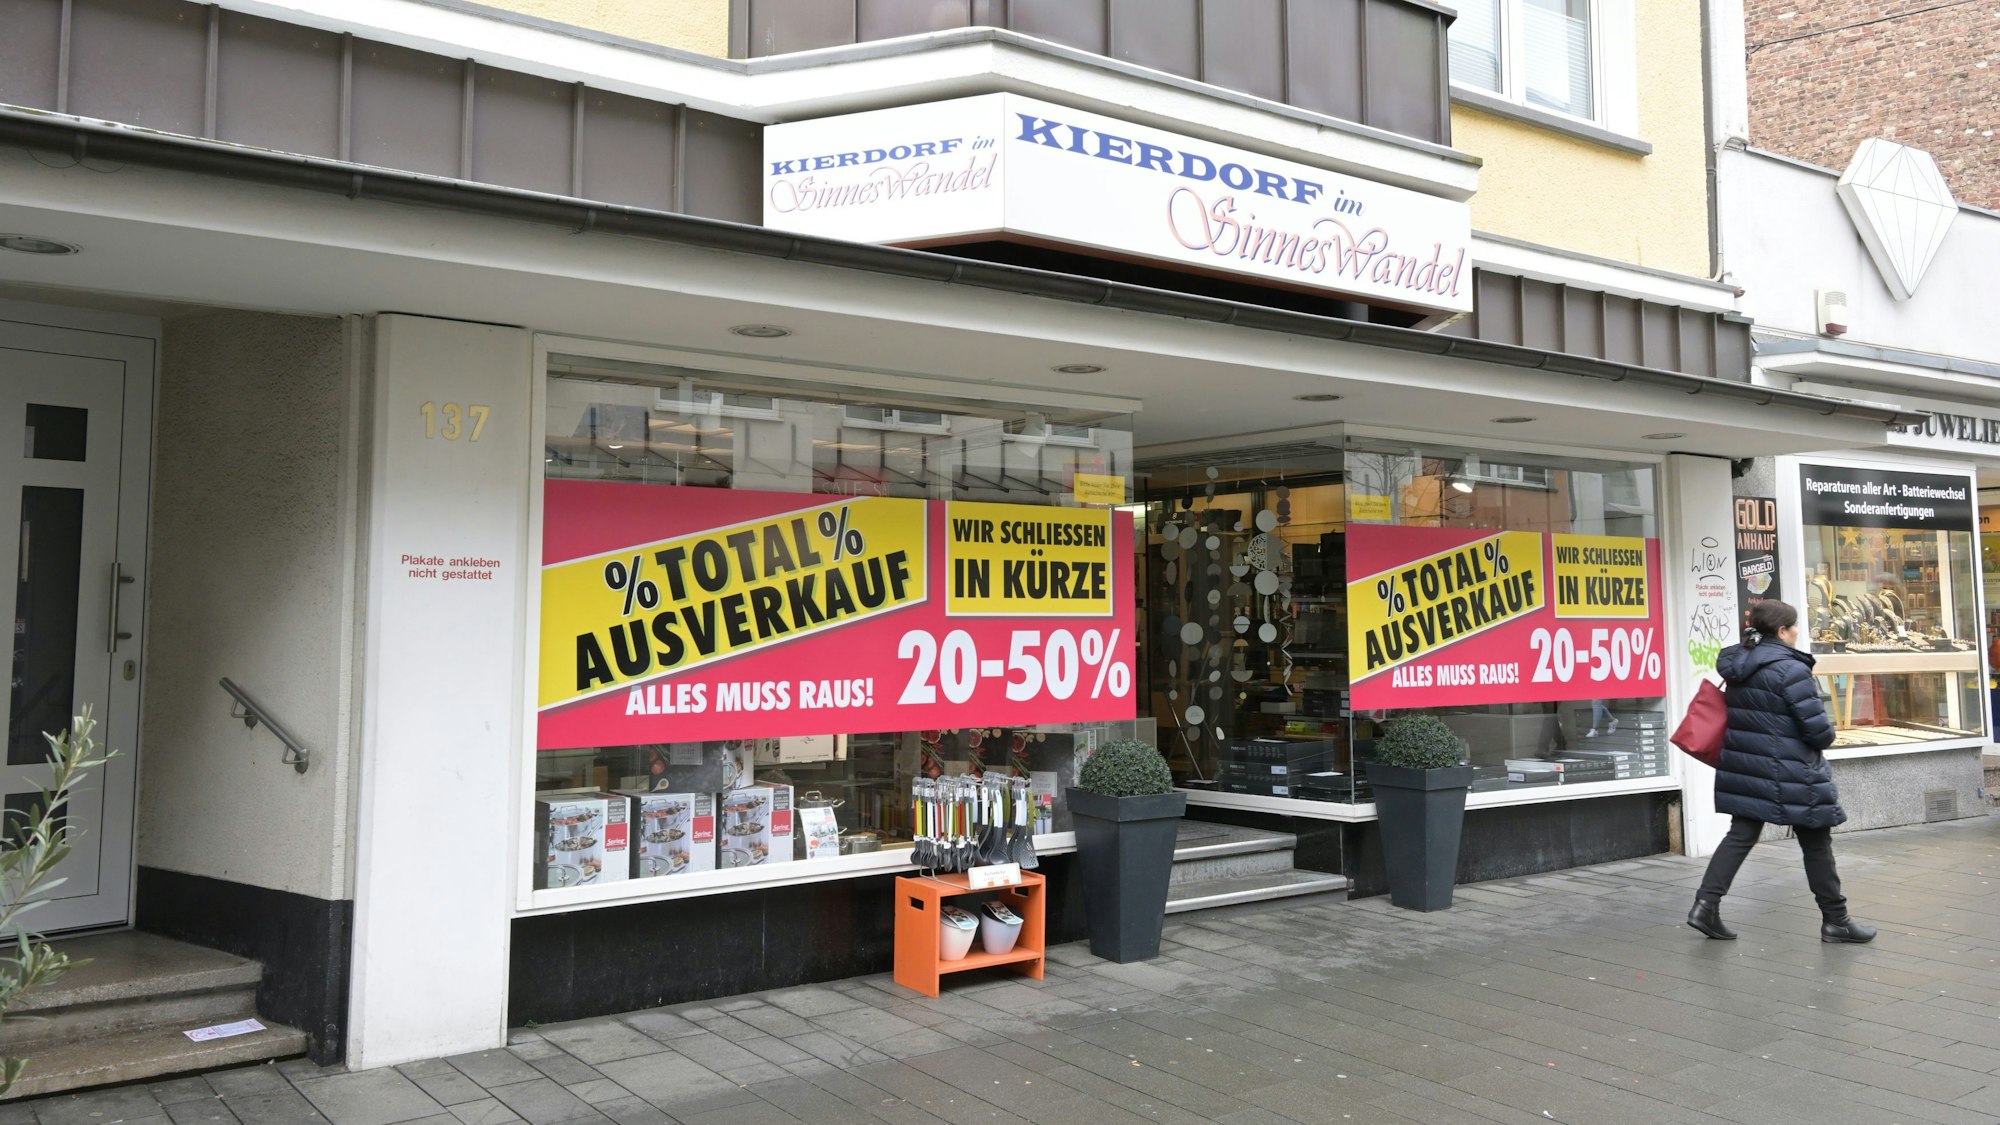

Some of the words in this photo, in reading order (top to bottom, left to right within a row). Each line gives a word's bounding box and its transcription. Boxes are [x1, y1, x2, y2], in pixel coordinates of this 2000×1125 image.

[770, 138, 962, 176] KIERDORF
[972, 136, 995, 150] im
[1018, 113, 1323, 204] KIERDORF
[1334, 189, 1364, 217] im
[770, 152, 998, 213] SinnesWandel
[1167, 186, 1466, 299] SinnesWandel
[420, 401, 490, 442] 137
[1806, 478, 1861, 496] Reparaturen
[1862, 481, 1882, 495] aller
[1883, 483, 1897, 496] Art
[1903, 485, 1966, 500] Batteriewechsel
[1736, 498, 1776, 531] GOLD
[1844, 501, 1935, 520] Sonderanfertigungen
[953, 518, 994, 544] WIR
[1000, 521, 1106, 548] SCHLIESSEN
[1737, 532, 1776, 551] ANKAUF
[401, 555, 445, 566] Plakate
[449, 557, 501, 568] ankleben
[408, 568, 437, 578] nicht
[442, 569, 492, 581] gestattet
[954, 558, 990, 598] IN
[1003, 550, 1106, 600] KÜRZE
[1556, 546, 1580, 564] WIR
[1583, 547, 1643, 567] SCHLIESSEN
[1742, 561, 1773, 576] BARGELD
[1558, 575, 1579, 605] IN
[1585, 568, 1645, 606] KÜRZE
[576, 549, 910, 691] AUSVERKAUF
[1365, 569, 1535, 671] AUSVERKAUF
[897, 628, 1131, 705] 20-50%
[1530, 627, 1661, 683] 20-50%
[1392, 665, 1433, 689] ALLES
[1437, 664, 1476, 686] MUSS
[1479, 662, 1519, 685] RAUS!
[625, 684, 707, 715] ALLES
[716, 681, 791, 712] MUSS
[799, 677, 874, 709] RAUS!
